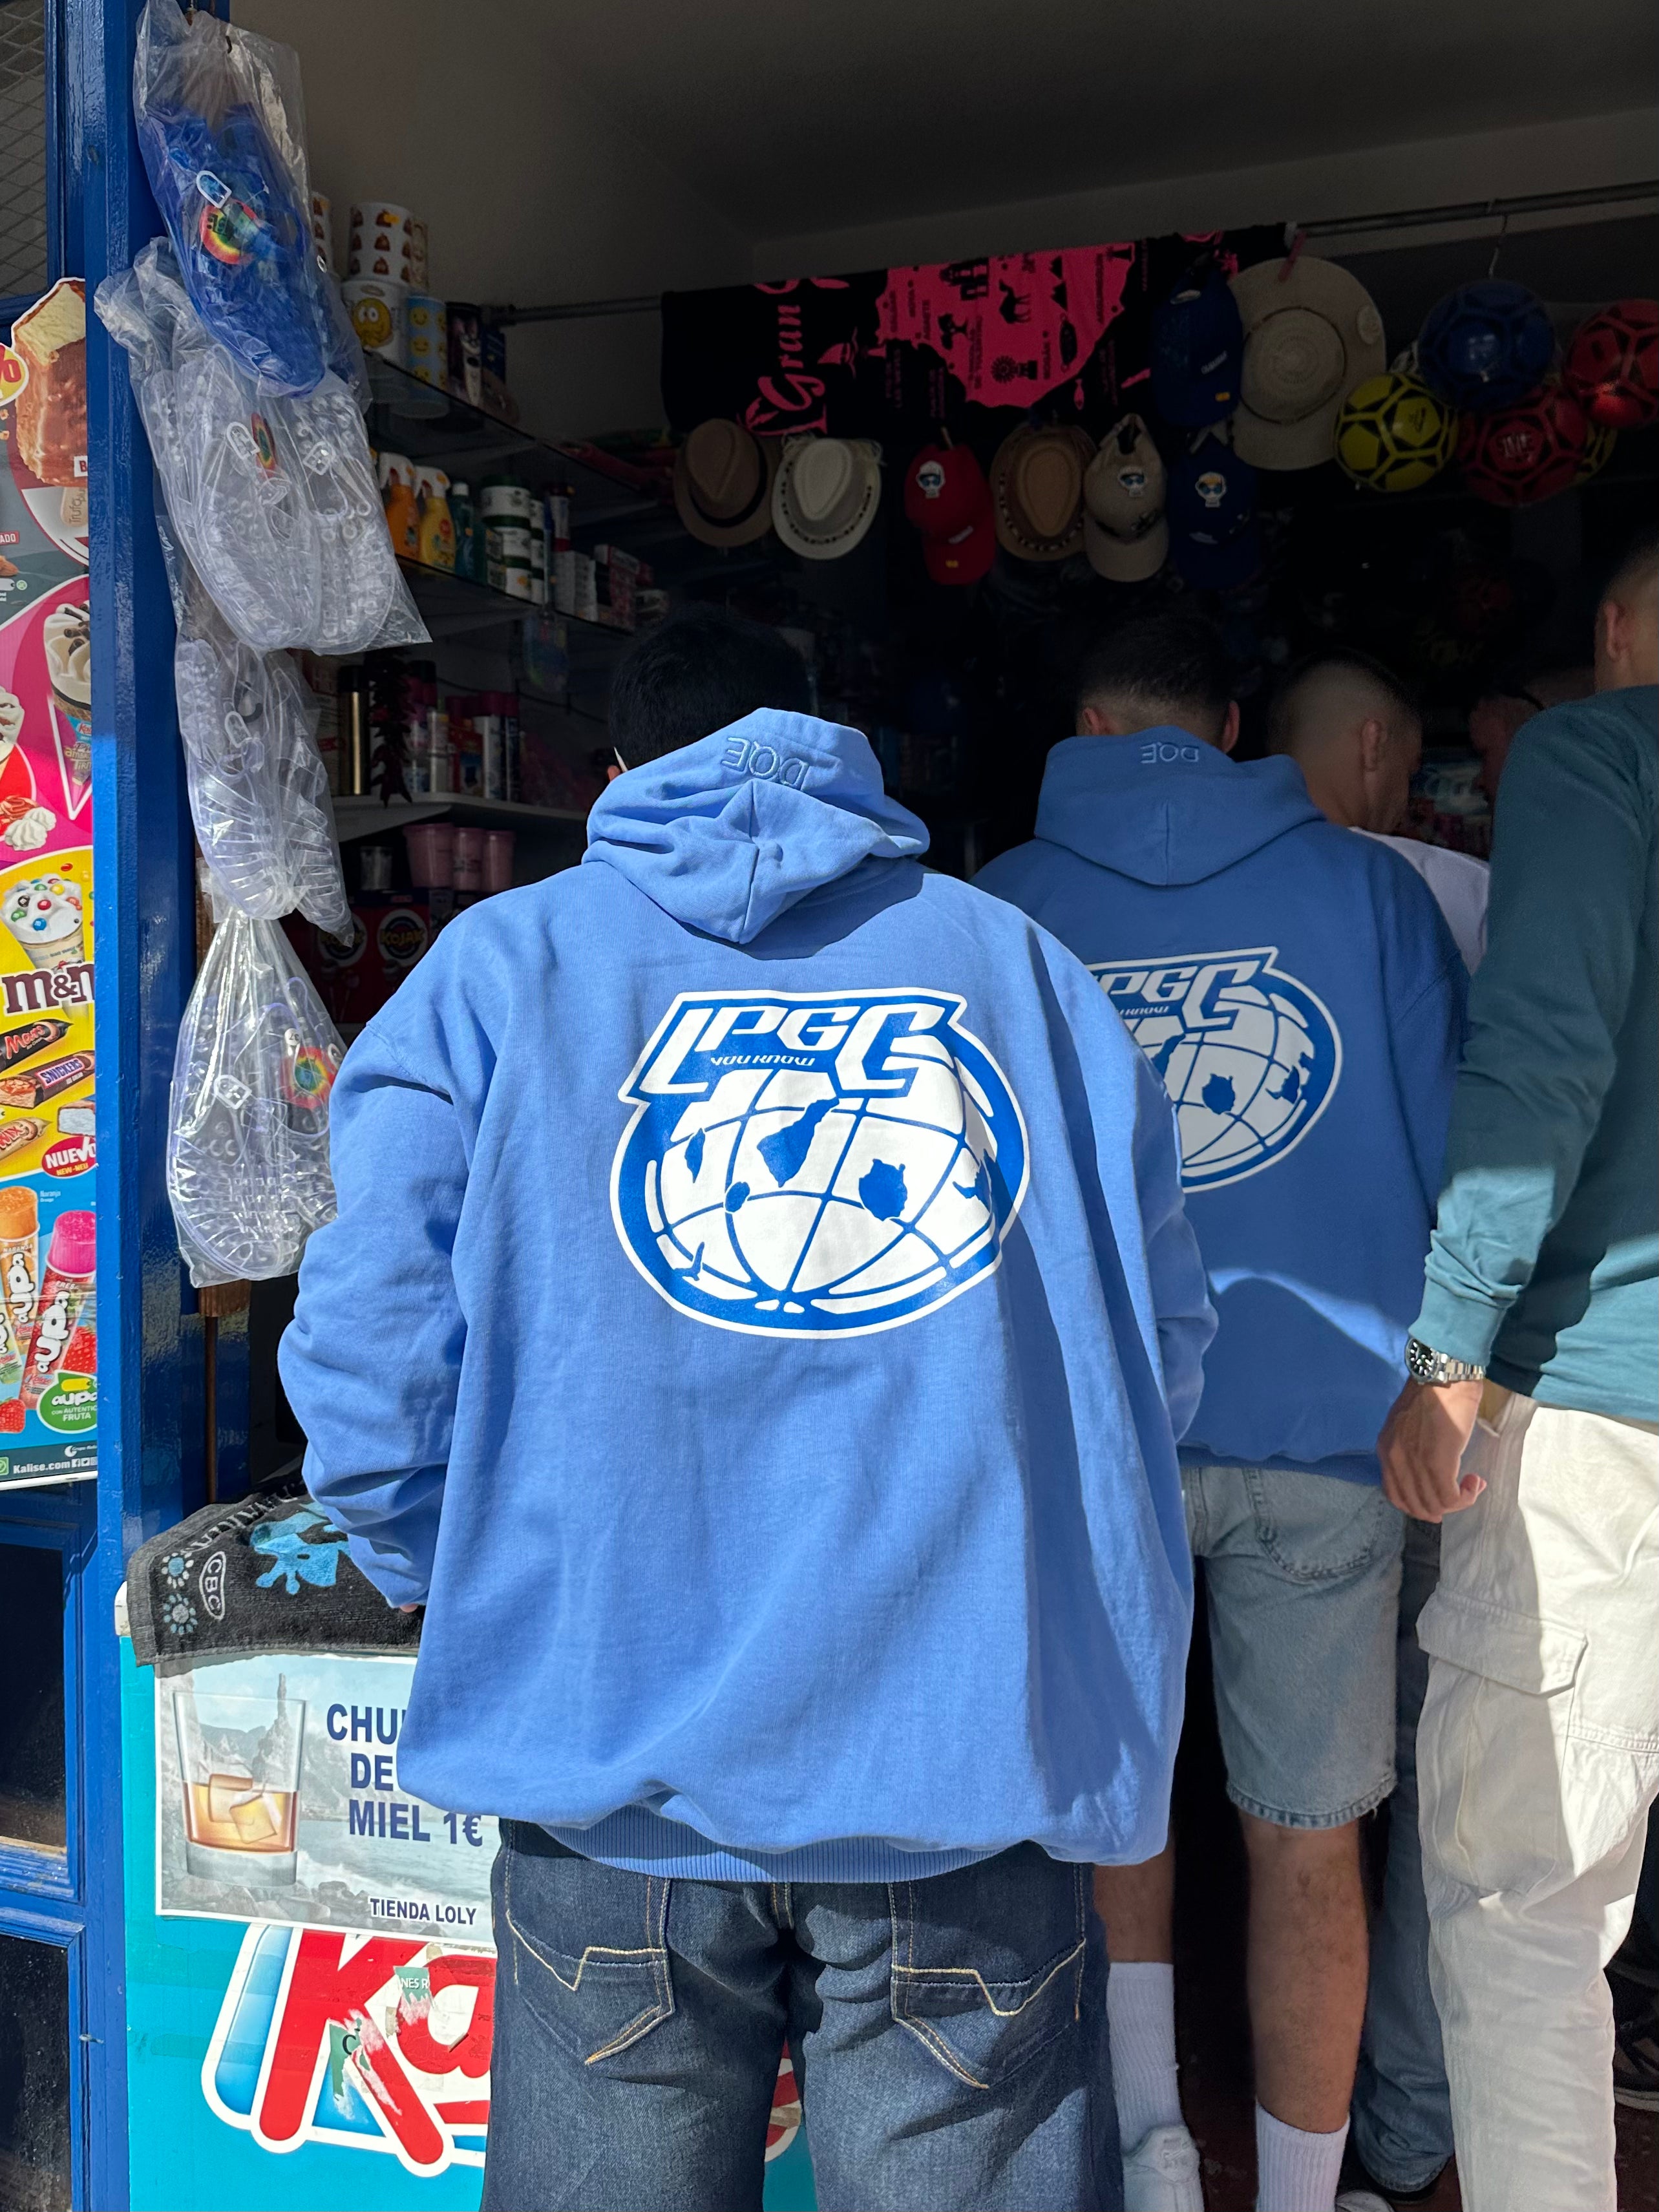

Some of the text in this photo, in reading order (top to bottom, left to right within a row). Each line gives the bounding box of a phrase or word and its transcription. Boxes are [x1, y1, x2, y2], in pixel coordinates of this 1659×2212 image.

[757, 305, 825, 411] Gran
[1092, 961, 1260, 1028] PGC
[5, 1026, 45, 1060] Mars
[639, 1003, 945, 1096] LPGC
[40, 1059, 83, 1084] SNICKERS
[63, 1412, 91, 1421] FRUTA
[13, 1461, 70, 1474] Kalise.com
[205, 1559, 222, 1610] CBC
[350, 1753, 393, 1791] DE
[349, 1799, 483, 1847] MIEL 1€
[370, 1897, 477, 1925] TIENDA LOLY
[401, 1977, 419, 1989] NES
